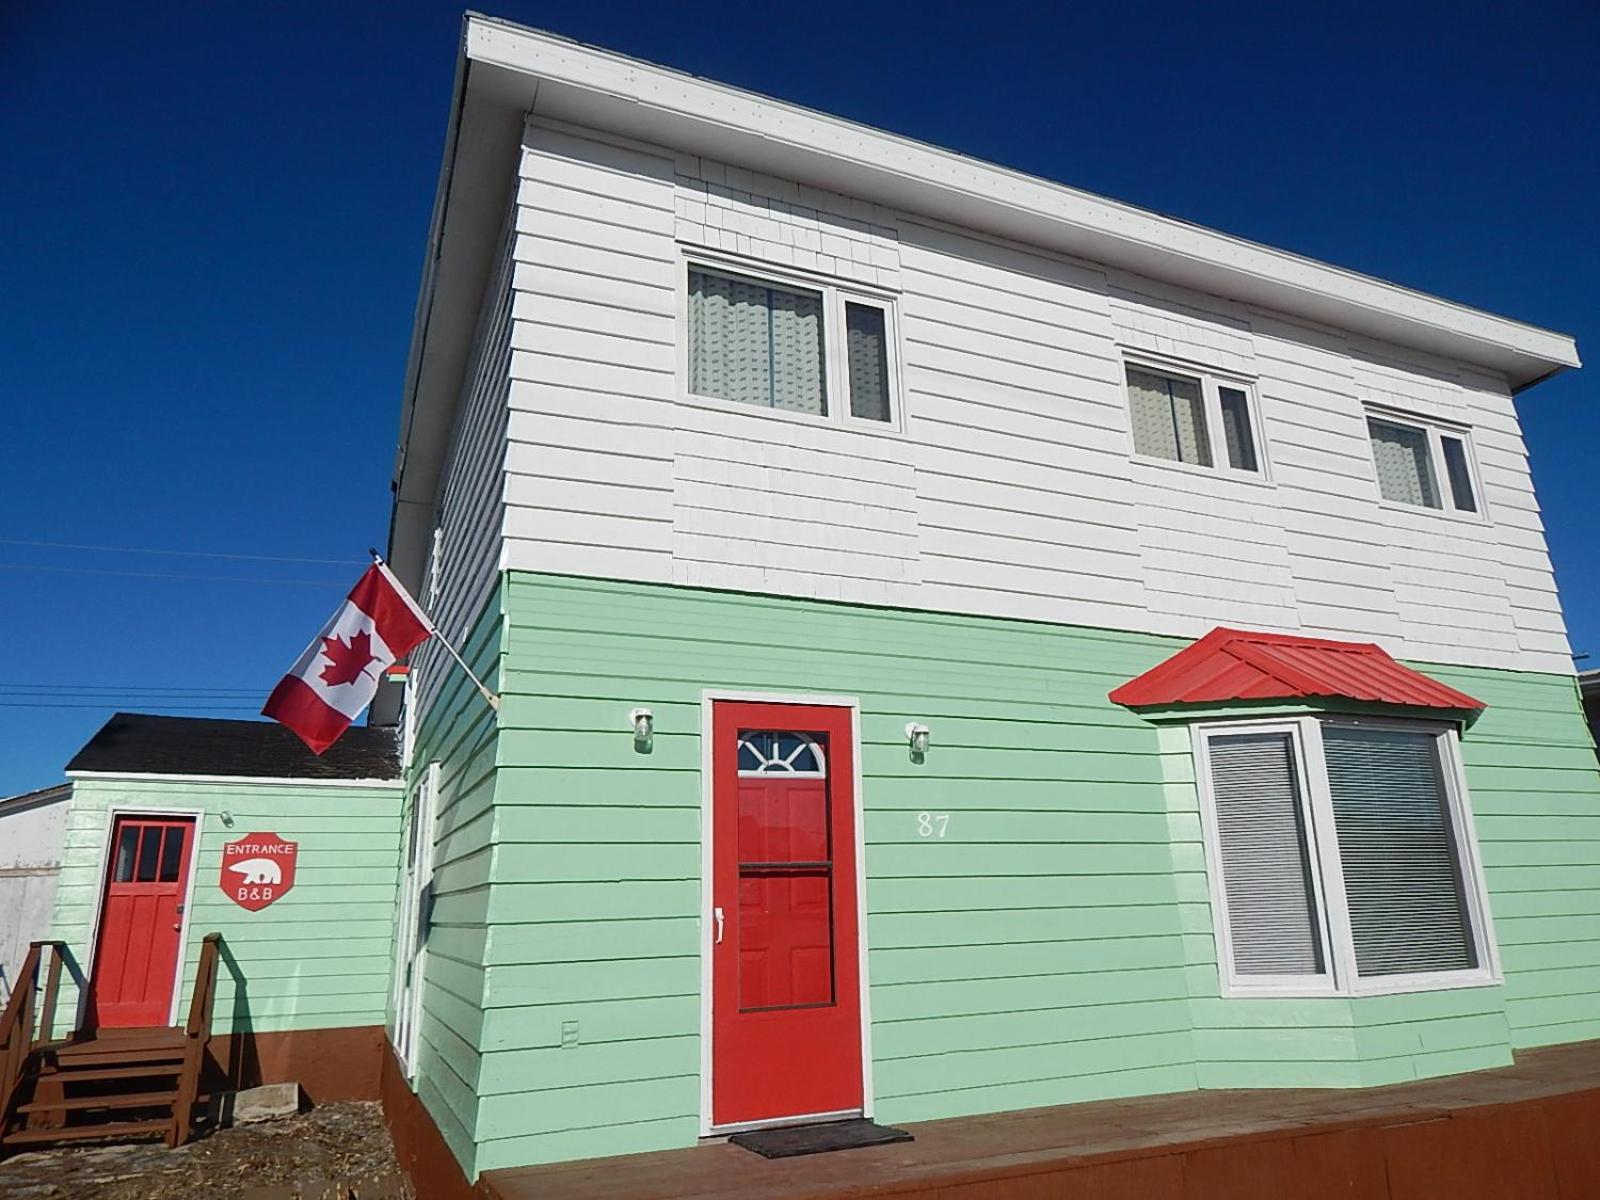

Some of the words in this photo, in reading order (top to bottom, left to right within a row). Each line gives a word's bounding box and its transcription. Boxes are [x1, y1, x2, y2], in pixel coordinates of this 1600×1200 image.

[918, 812, 949, 837] 87
[226, 844, 294, 855] ENTRANCE
[238, 887, 273, 900] B&B
